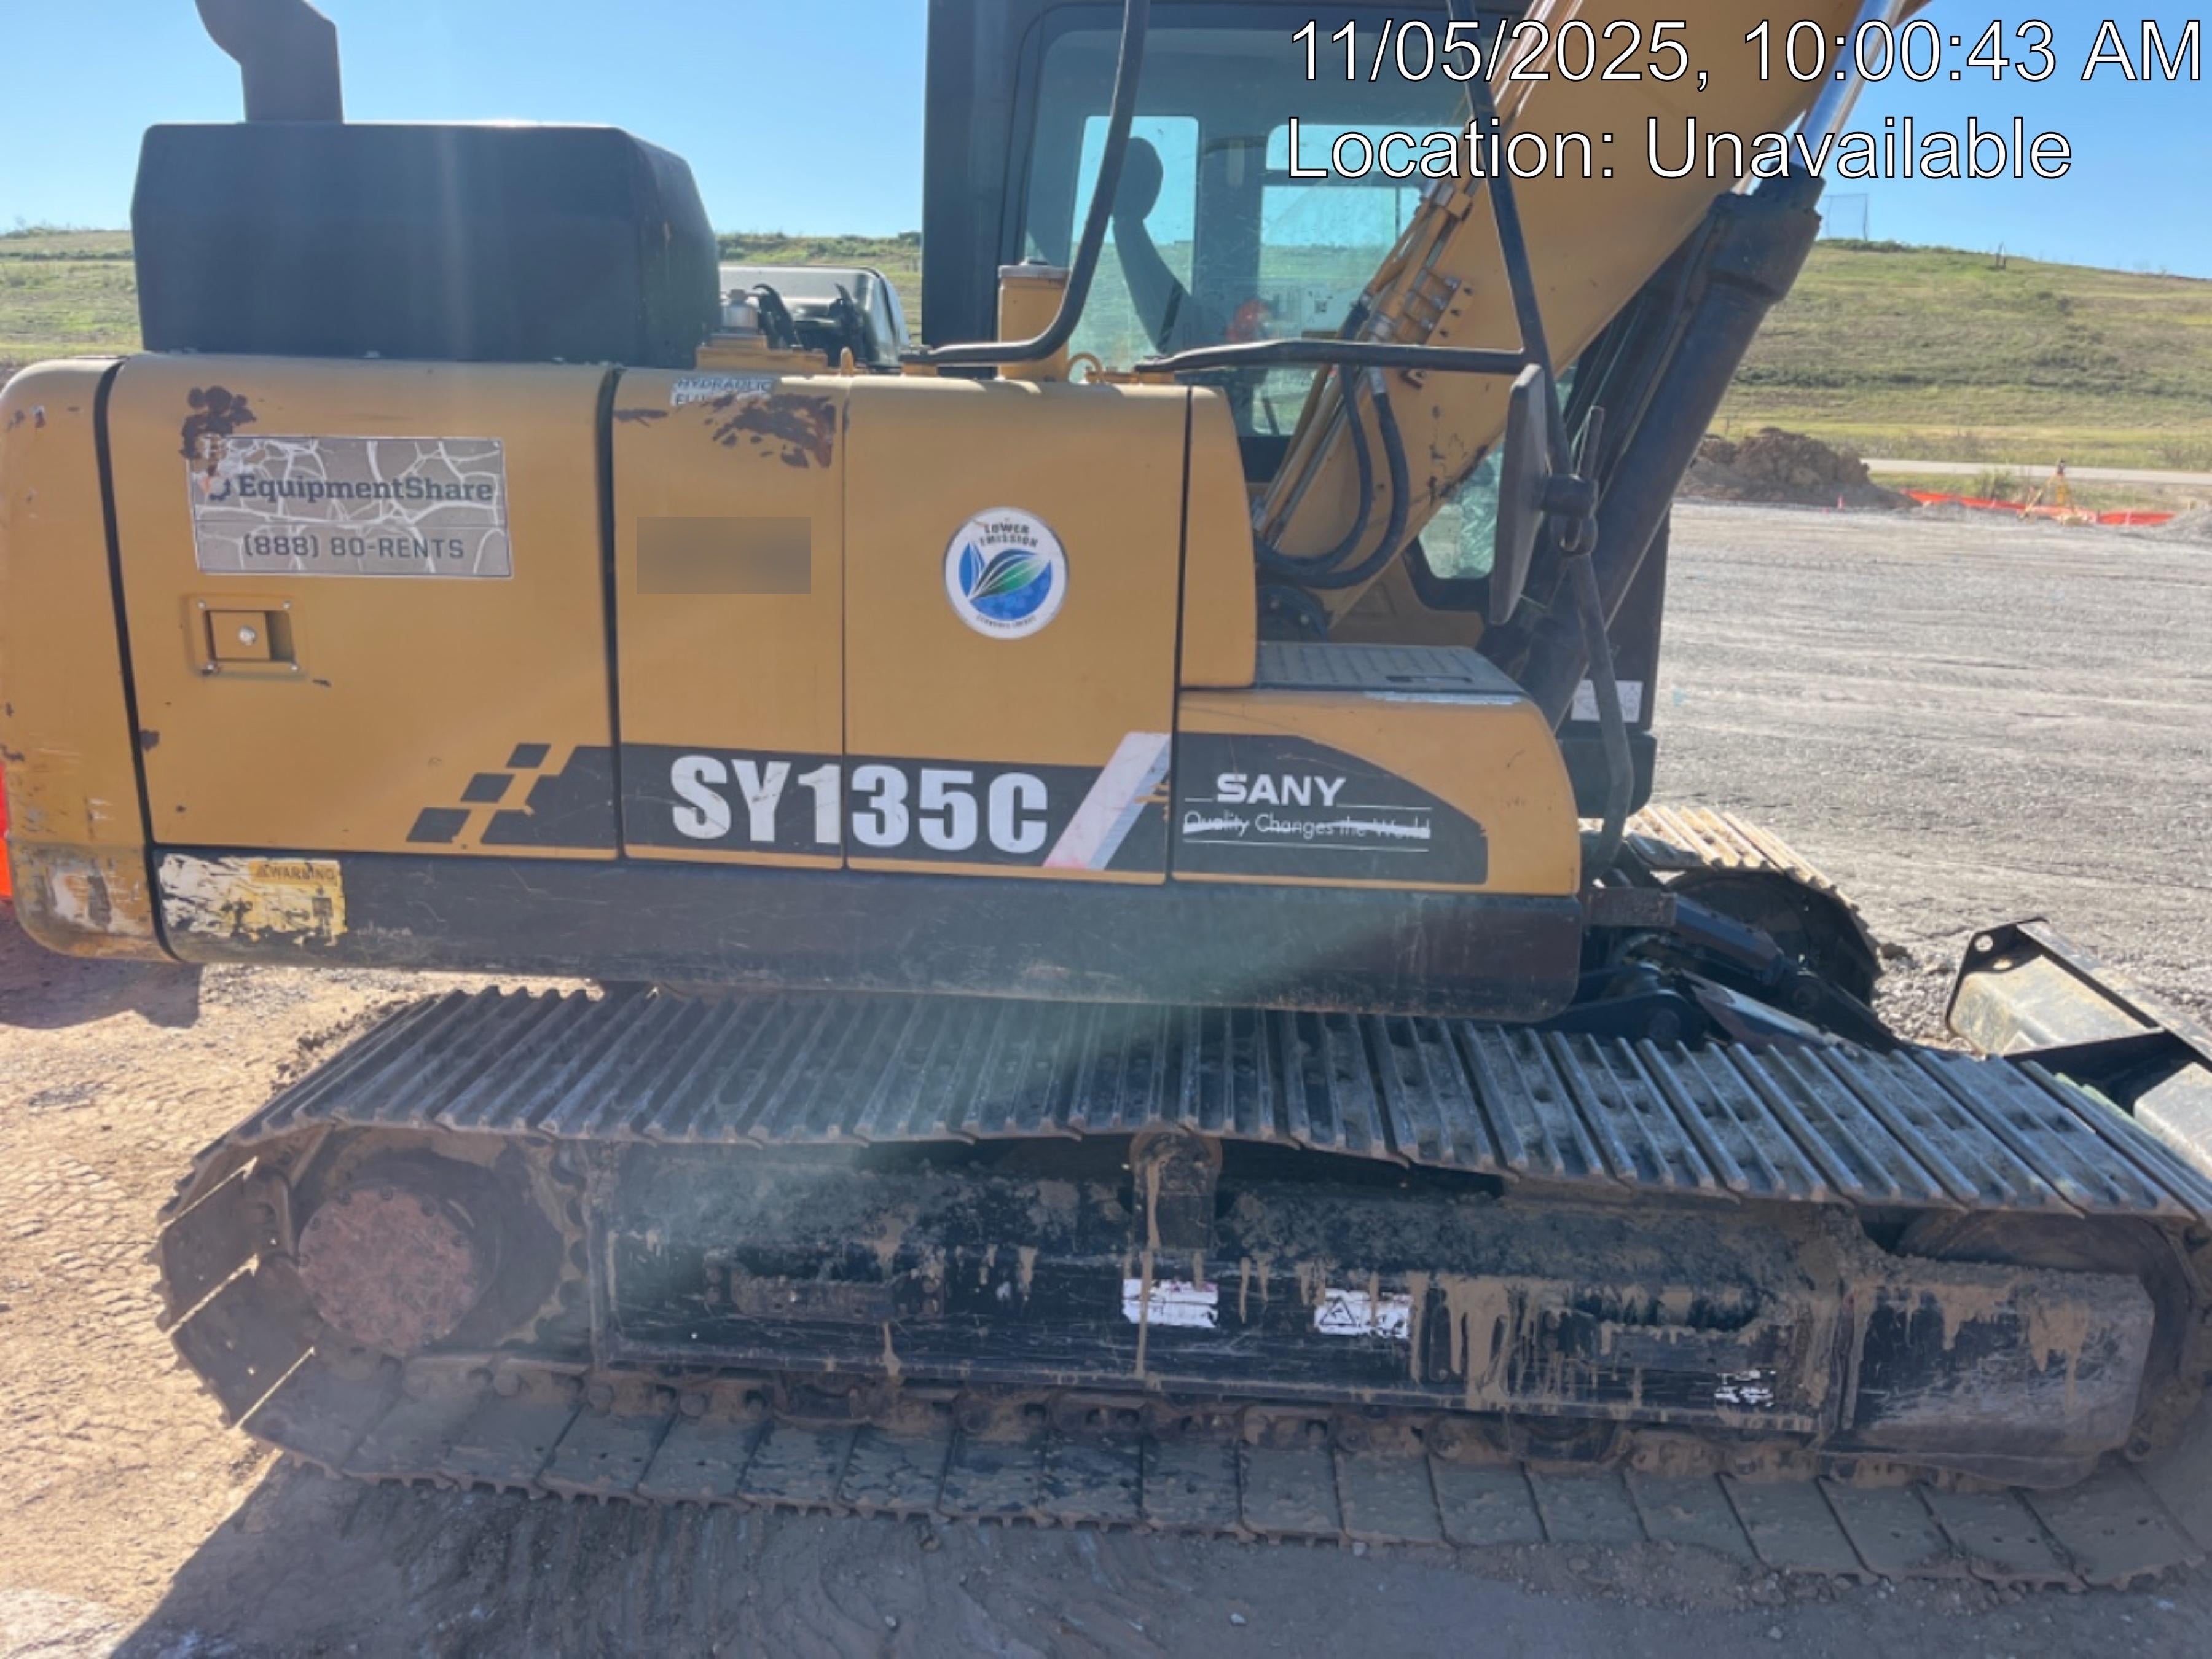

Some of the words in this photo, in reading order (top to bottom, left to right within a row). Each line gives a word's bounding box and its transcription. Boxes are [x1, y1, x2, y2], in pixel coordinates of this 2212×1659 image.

[677, 378, 771, 392] HYDRAULIC
[237, 474, 492, 503] EquipmentShare
[980, 534, 1038, 547] EMISSION
[984, 523, 1030, 533] LOWER
[245, 535, 319, 558] (888)
[331, 536, 464, 559] 80-RENTS
[1217, 772, 1347, 807] SANY
[670, 755, 1048, 854] SY135C
[1183, 810, 1250, 837] Quality
[1255, 812, 1334, 839] Changes
[1338, 815, 1366, 837] the
